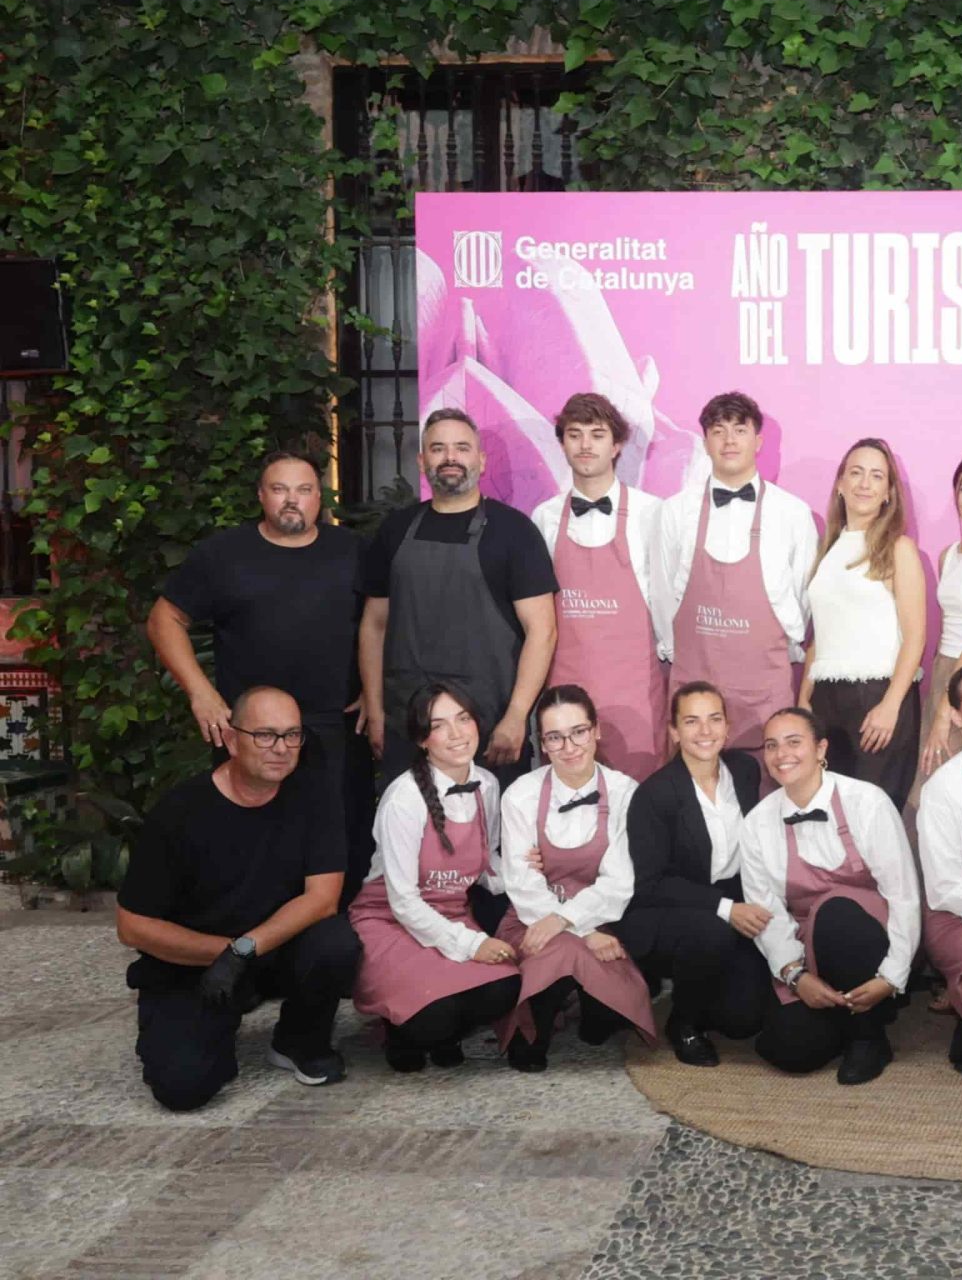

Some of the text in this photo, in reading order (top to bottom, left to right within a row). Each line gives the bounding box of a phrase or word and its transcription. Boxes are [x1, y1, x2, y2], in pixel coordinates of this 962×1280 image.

[515, 236, 667, 261] Generalitat
[731, 221, 789, 298] AÑO
[515, 267, 695, 296] de Catalunya
[739, 301, 789, 365] DEL
[428, 869, 459, 880] TASTY
